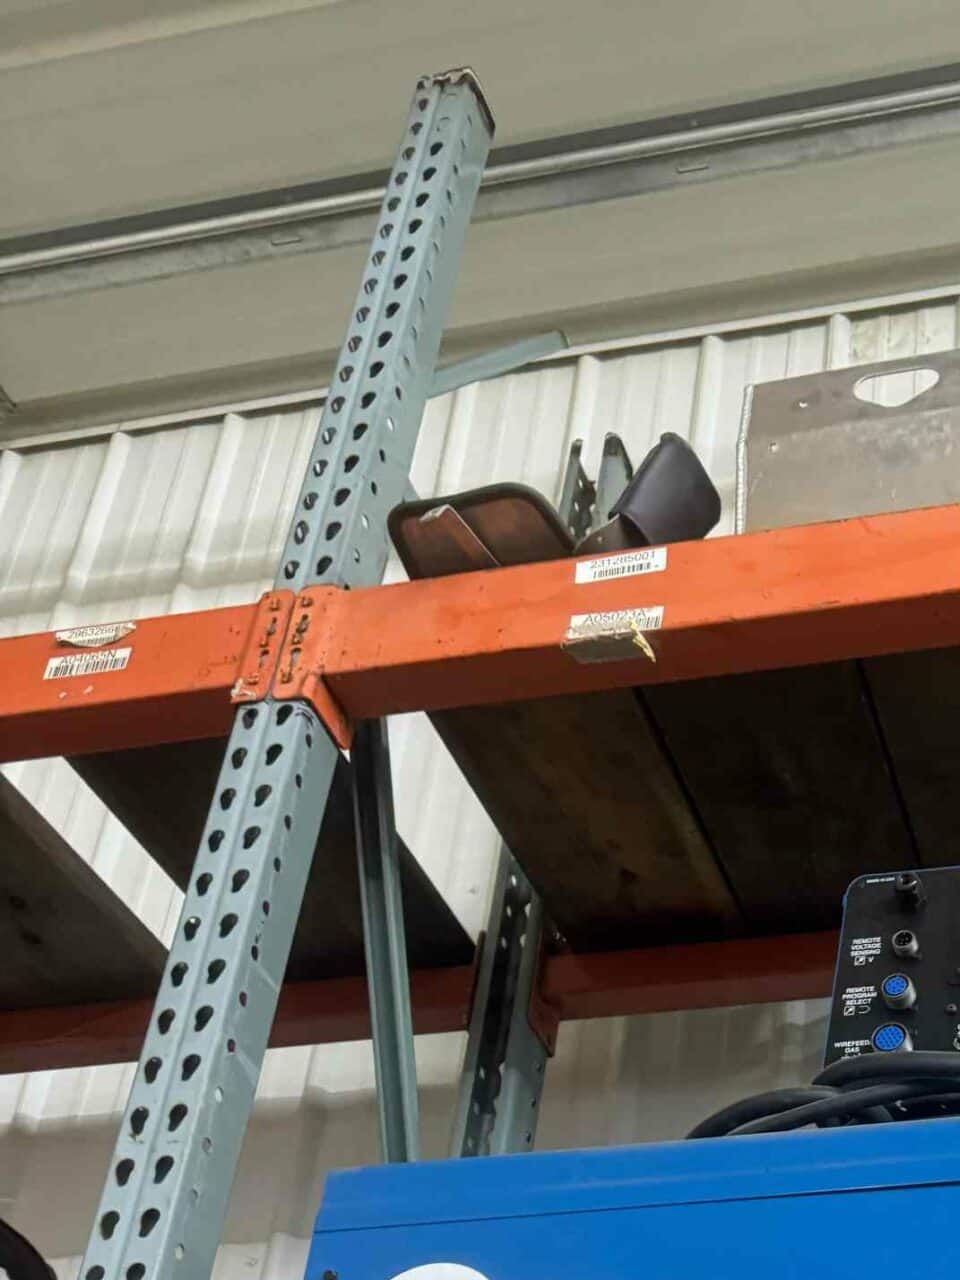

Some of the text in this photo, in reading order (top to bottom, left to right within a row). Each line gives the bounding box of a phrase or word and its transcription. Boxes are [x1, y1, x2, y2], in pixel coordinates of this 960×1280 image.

[852, 936, 882, 945] REMOTE
[850, 942, 882, 950] VOLTAGE
[845, 985, 875, 994] REMOTE
[842, 991, 878, 1000] PROGRAM
